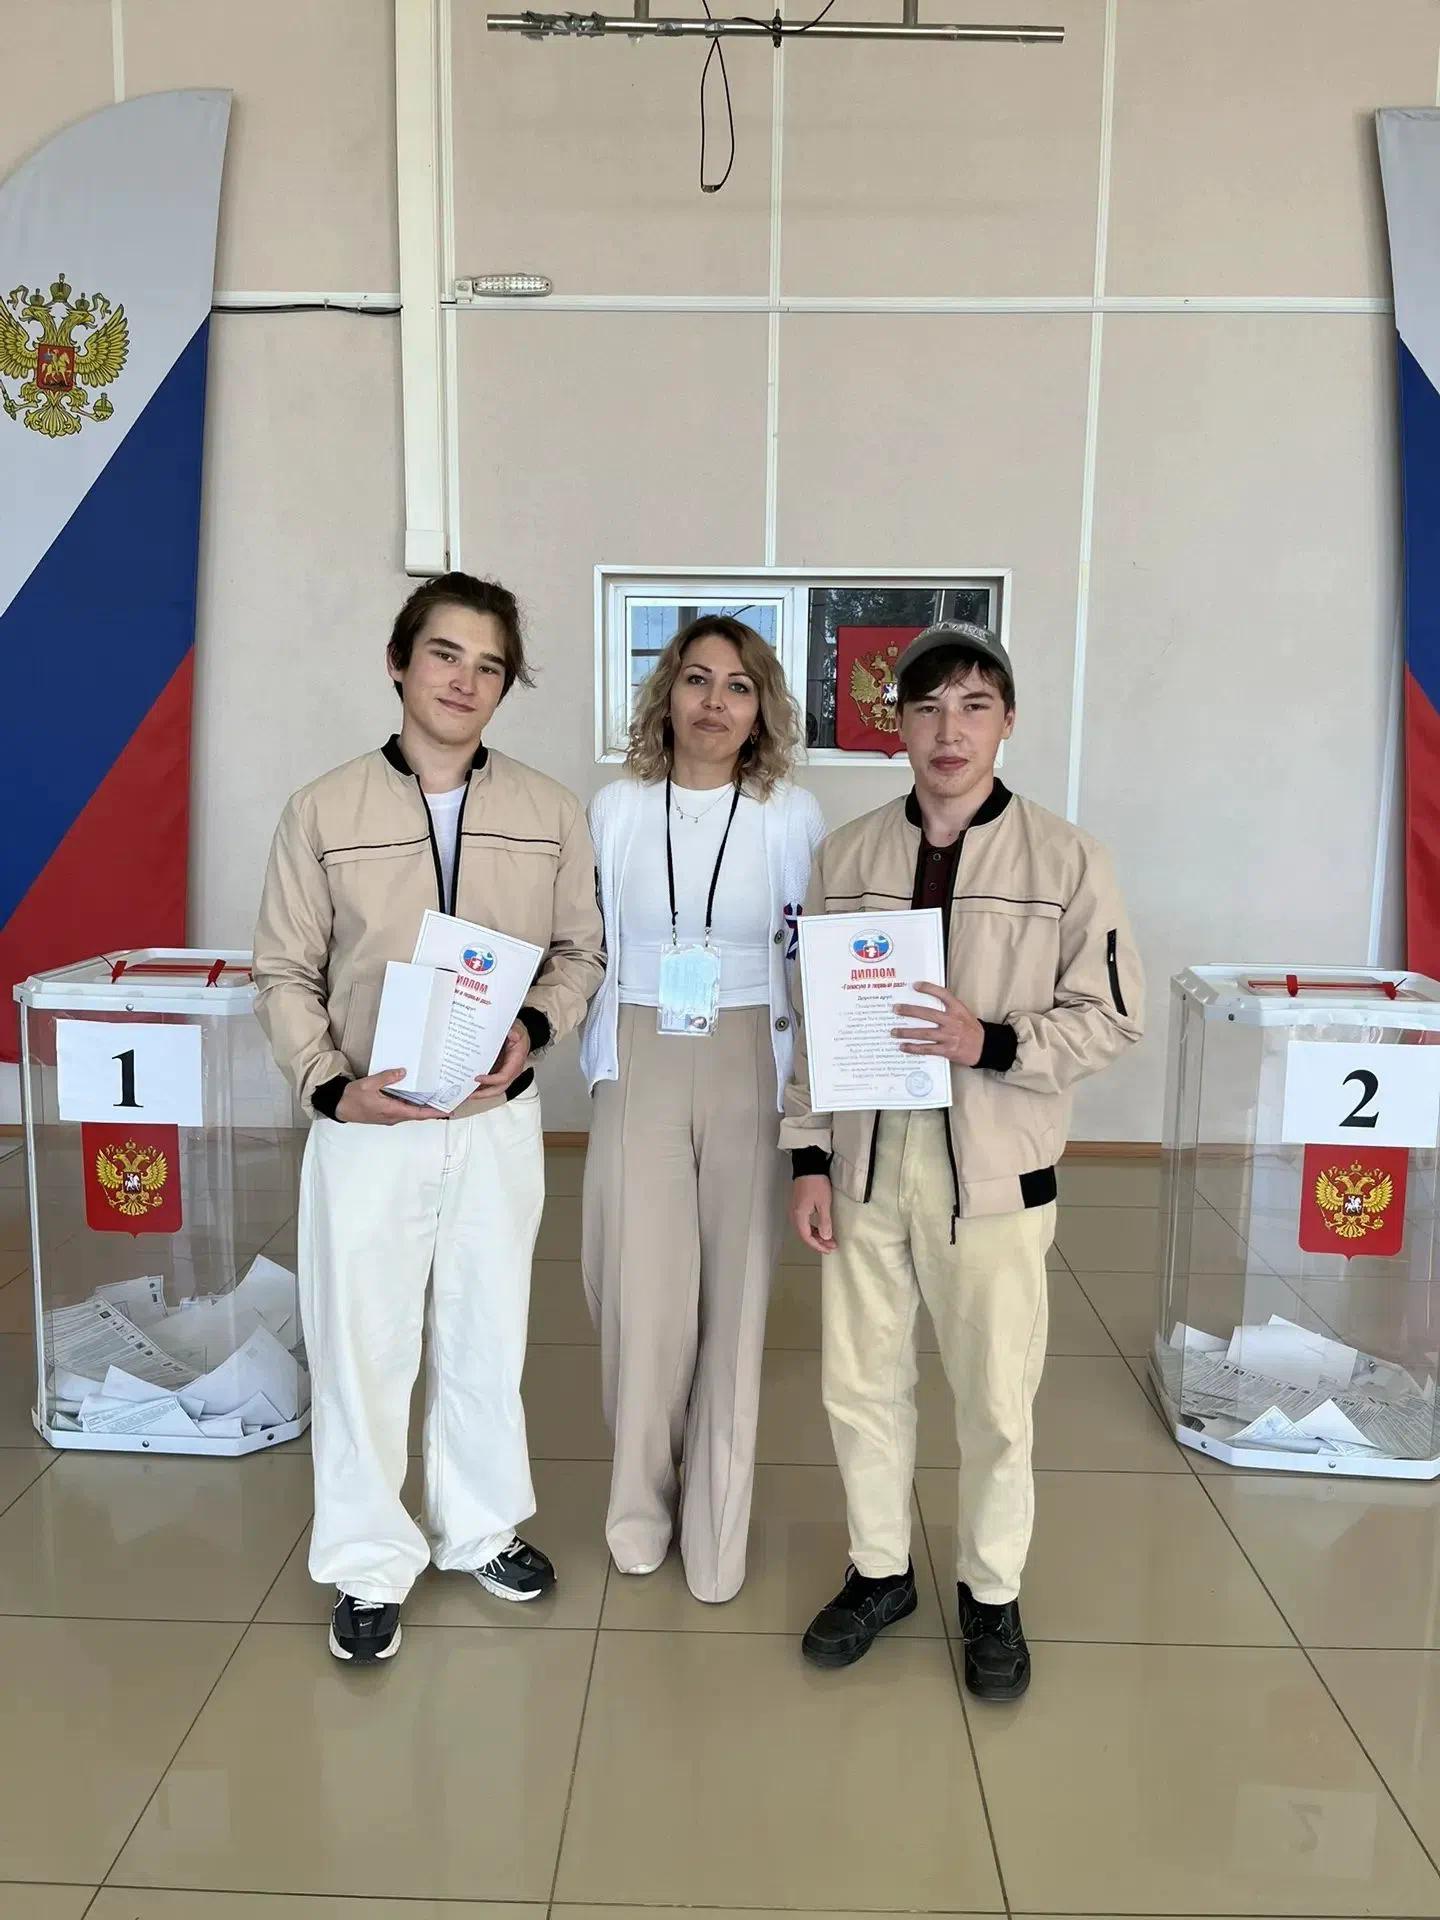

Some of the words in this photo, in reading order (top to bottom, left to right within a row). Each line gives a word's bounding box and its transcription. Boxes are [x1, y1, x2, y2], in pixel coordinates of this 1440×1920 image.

[456, 975, 488, 993] ИПЛОМ
[851, 967, 896, 980] ДИПЛОМ
[112, 1048, 144, 1108] 1
[1338, 1069, 1380, 1128] 2
